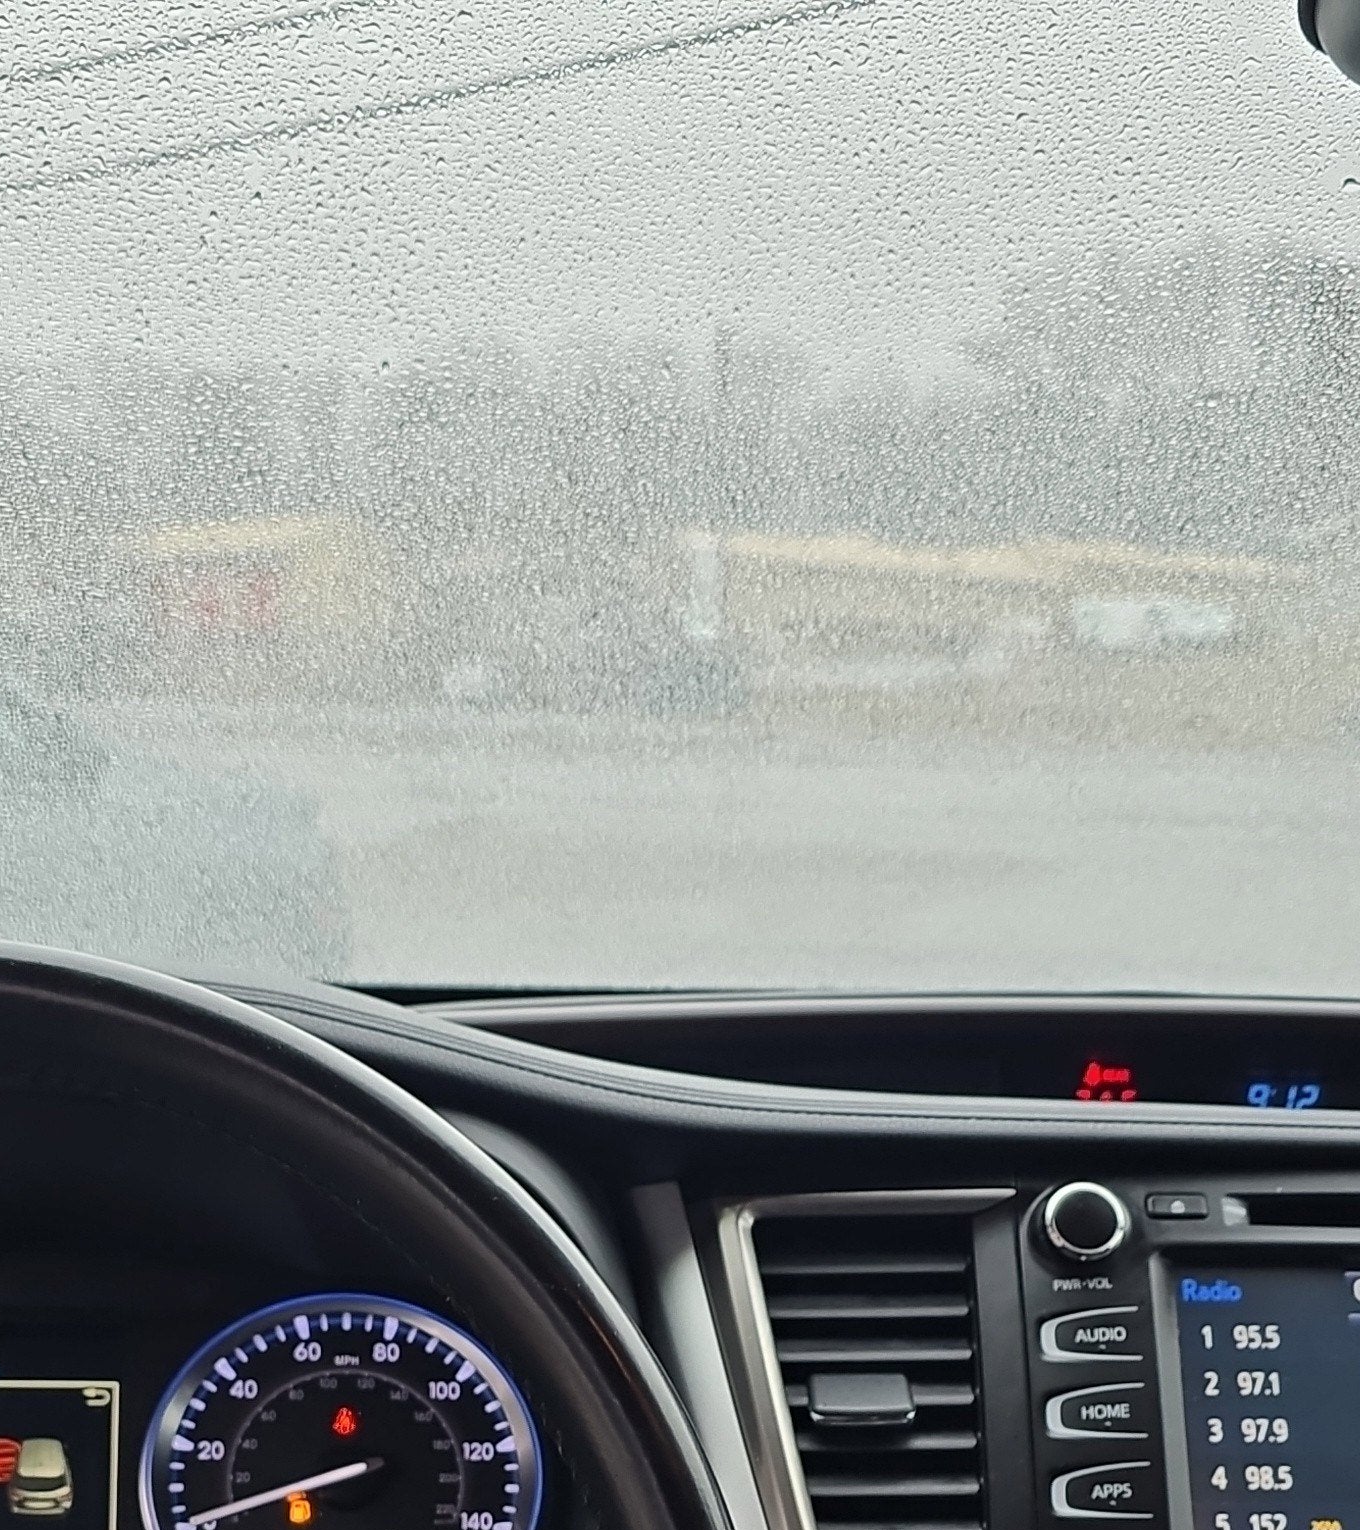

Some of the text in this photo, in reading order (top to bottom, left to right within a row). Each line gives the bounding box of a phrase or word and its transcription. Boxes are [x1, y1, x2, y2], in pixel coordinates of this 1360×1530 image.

[1181, 1278, 1242, 1302] Radio
[1074, 1326, 1127, 1344] AUDIO
[1201, 1324, 1281, 1350] 1 95.5
[293, 1342, 322, 1362] 60
[334, 1355, 360, 1367] MPH
[372, 1343, 400, 1362] 80
[229, 1379, 259, 1399] 40
[428, 1380, 461, 1400] 100
[1203, 1371, 1281, 1396] 2 97.1
[1080, 1403, 1131, 1420] HOME
[1207, 1418, 1289, 1443] 3 97.9
[197, 1440, 226, 1461] 20
[462, 1442, 495, 1461] 120
[1210, 1465, 1293, 1490] 4 98.5
[1091, 1483, 1133, 1500] APPS
[460, 1511, 494, 1530] 140
